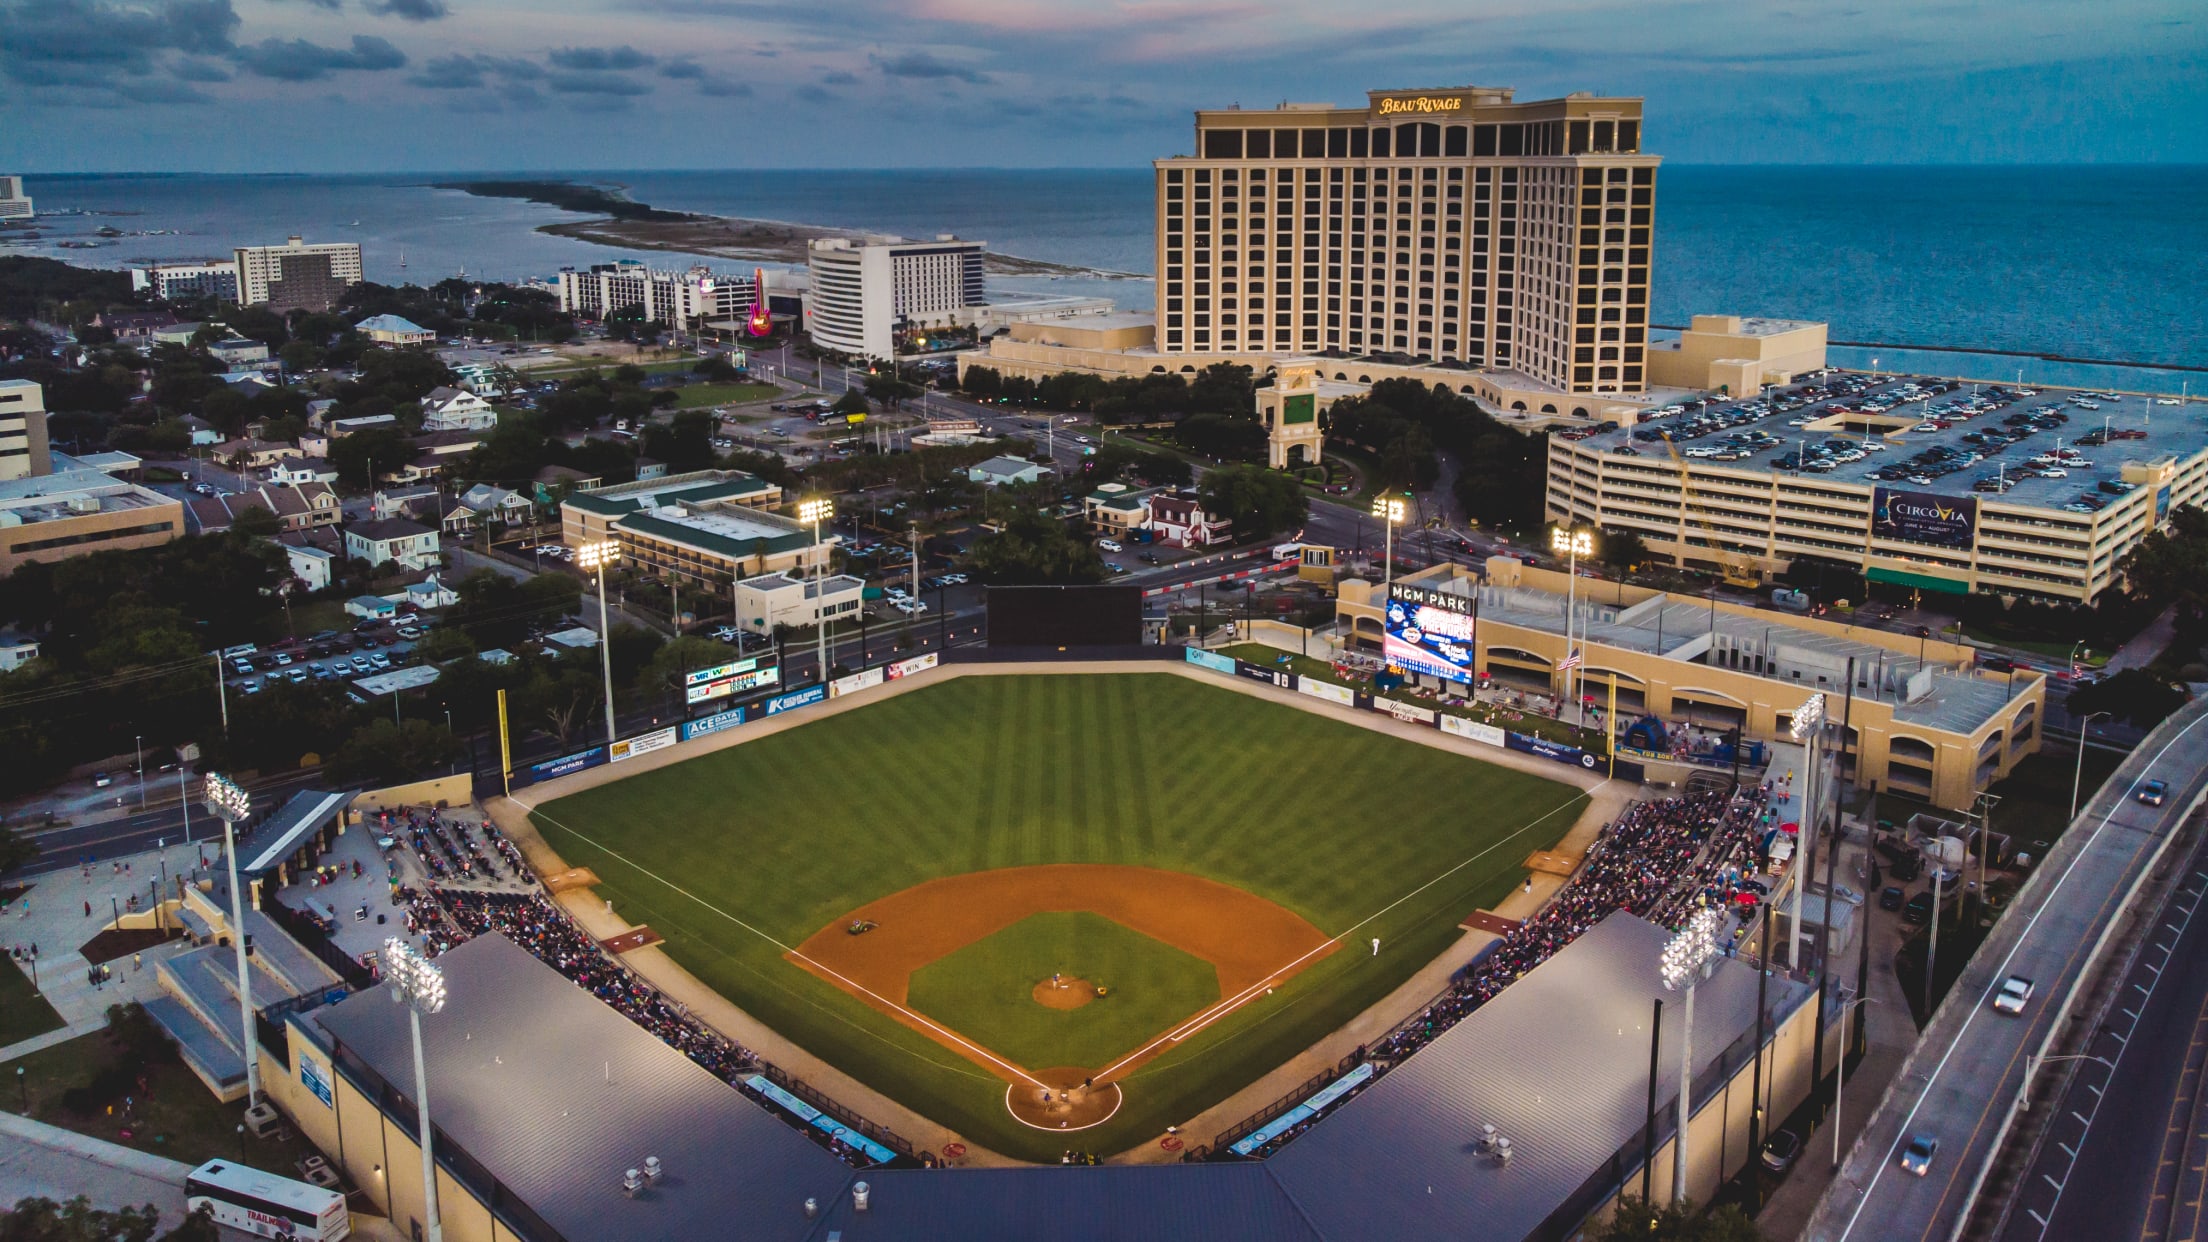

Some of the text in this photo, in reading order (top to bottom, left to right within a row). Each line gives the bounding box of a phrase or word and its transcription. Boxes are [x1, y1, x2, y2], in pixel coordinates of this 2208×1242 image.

[1896, 501, 1968, 527] CIRCOVIA
[1392, 586, 1466, 611] MGM PARK
[906, 663, 920, 673] WIN
[690, 719, 715, 734] ACE
[551, 760, 585, 773] MGM PARK
